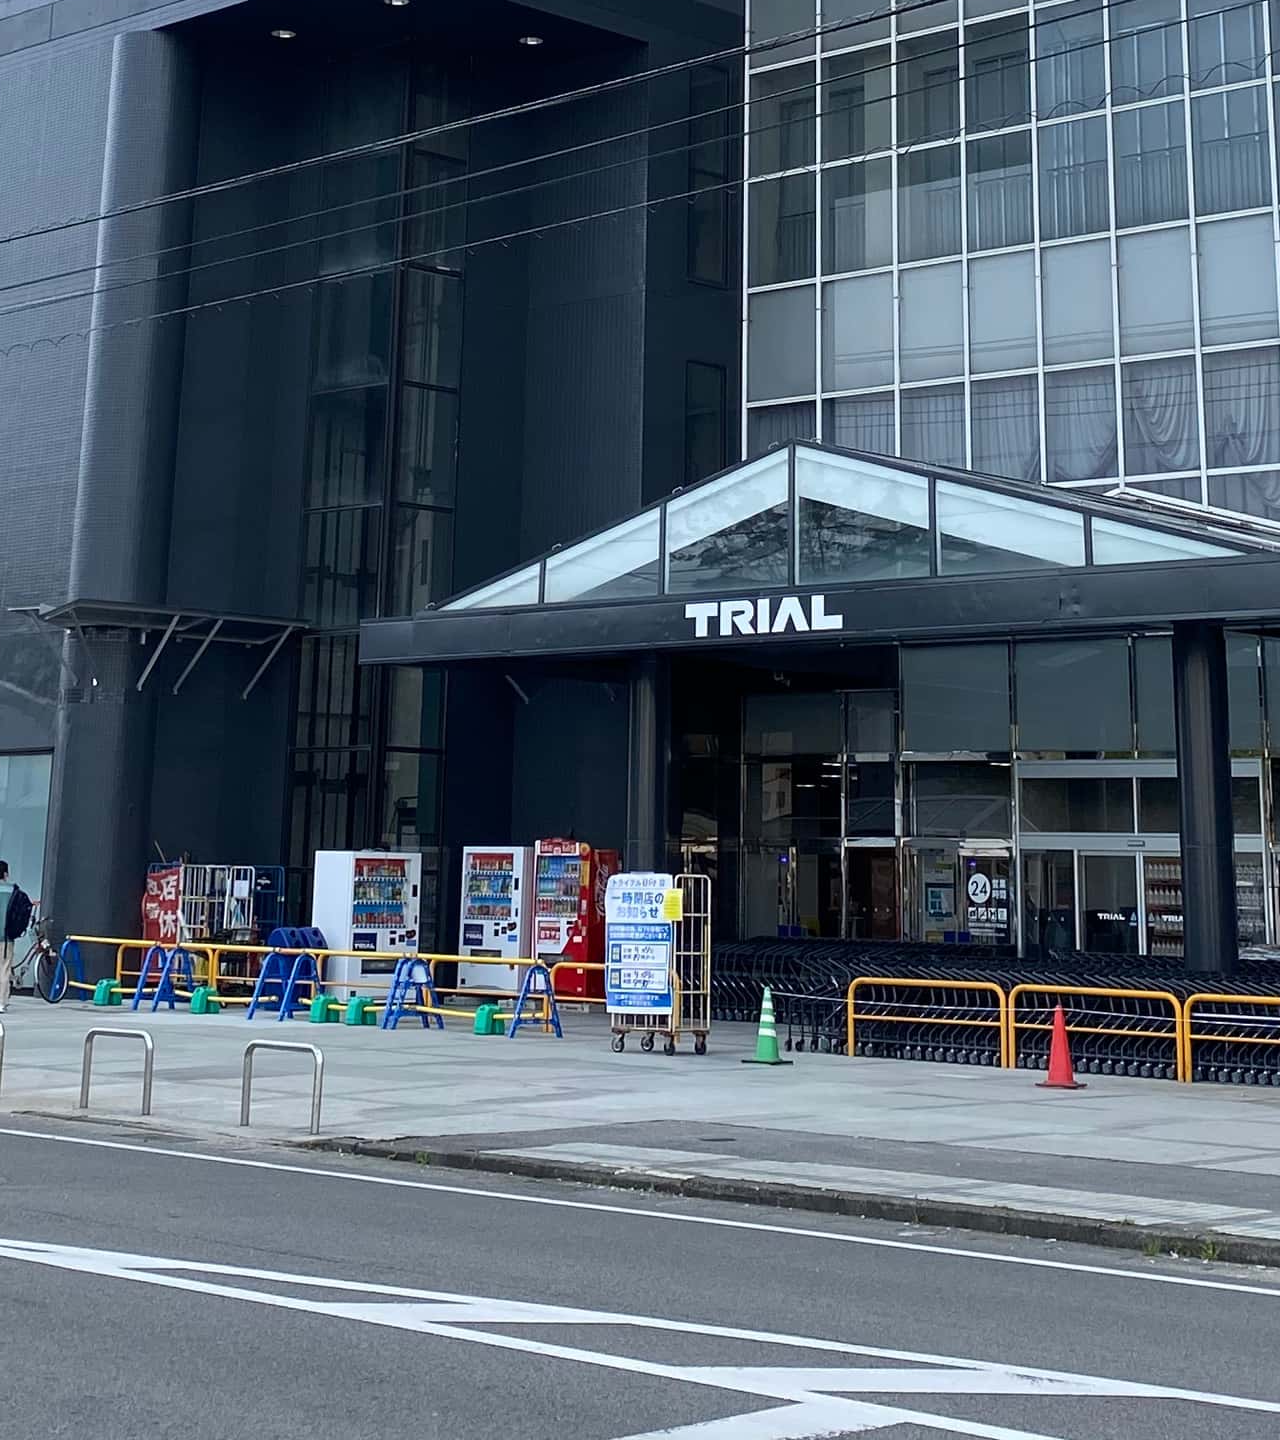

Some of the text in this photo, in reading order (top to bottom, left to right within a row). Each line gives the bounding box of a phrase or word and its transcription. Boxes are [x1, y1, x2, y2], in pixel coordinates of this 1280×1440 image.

[685, 594, 844, 638] TRIAL
[971, 880, 988, 896] 24
[1097, 912, 1125, 921] TRIAL
